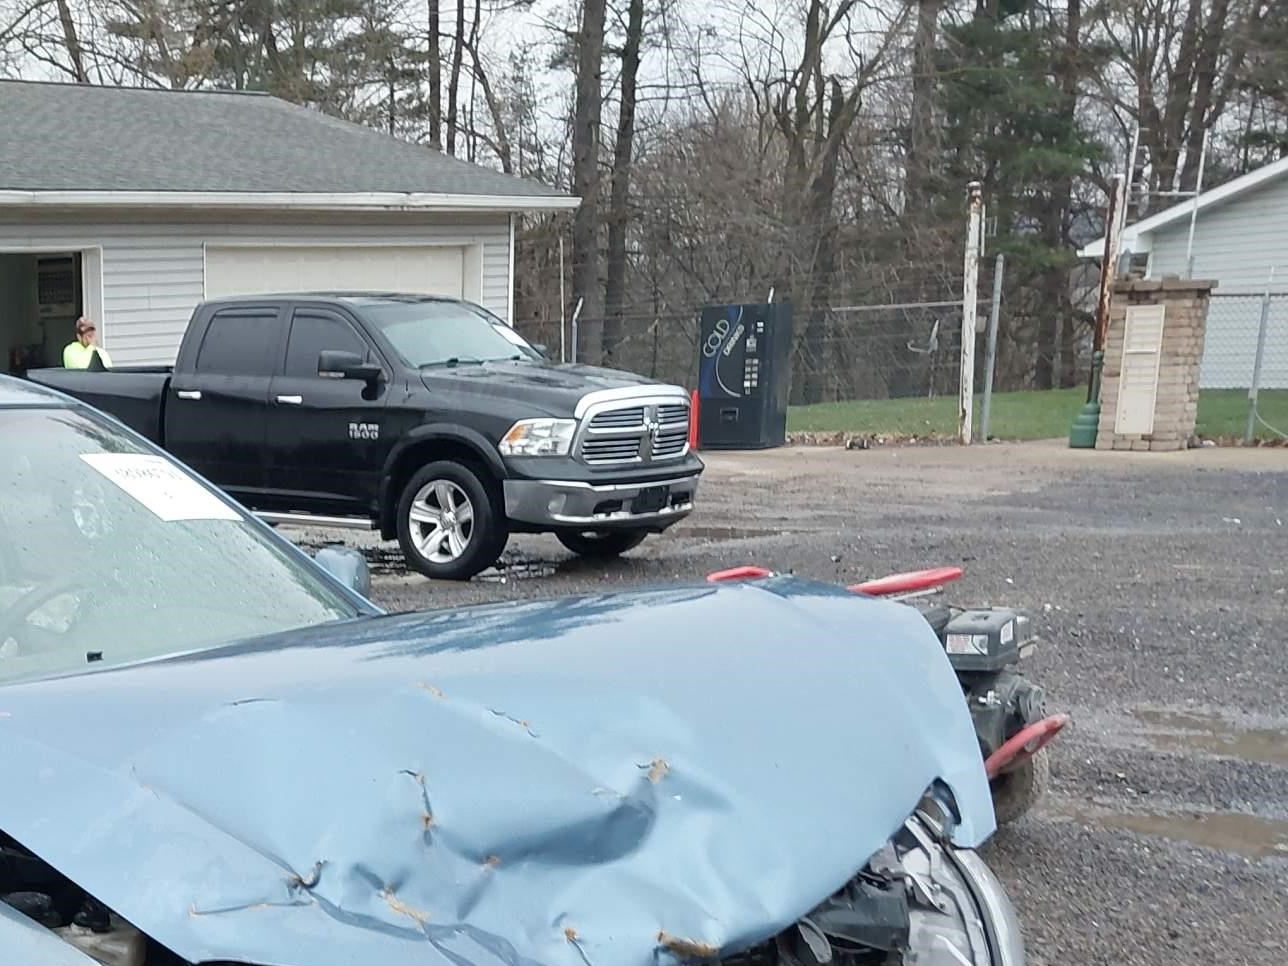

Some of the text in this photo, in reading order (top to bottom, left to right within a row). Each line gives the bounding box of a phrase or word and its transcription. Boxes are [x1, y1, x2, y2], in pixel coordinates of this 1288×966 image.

[704, 320, 730, 358] COLD
[348, 423, 380, 431] RAM
[348, 430, 380, 440] 1500
